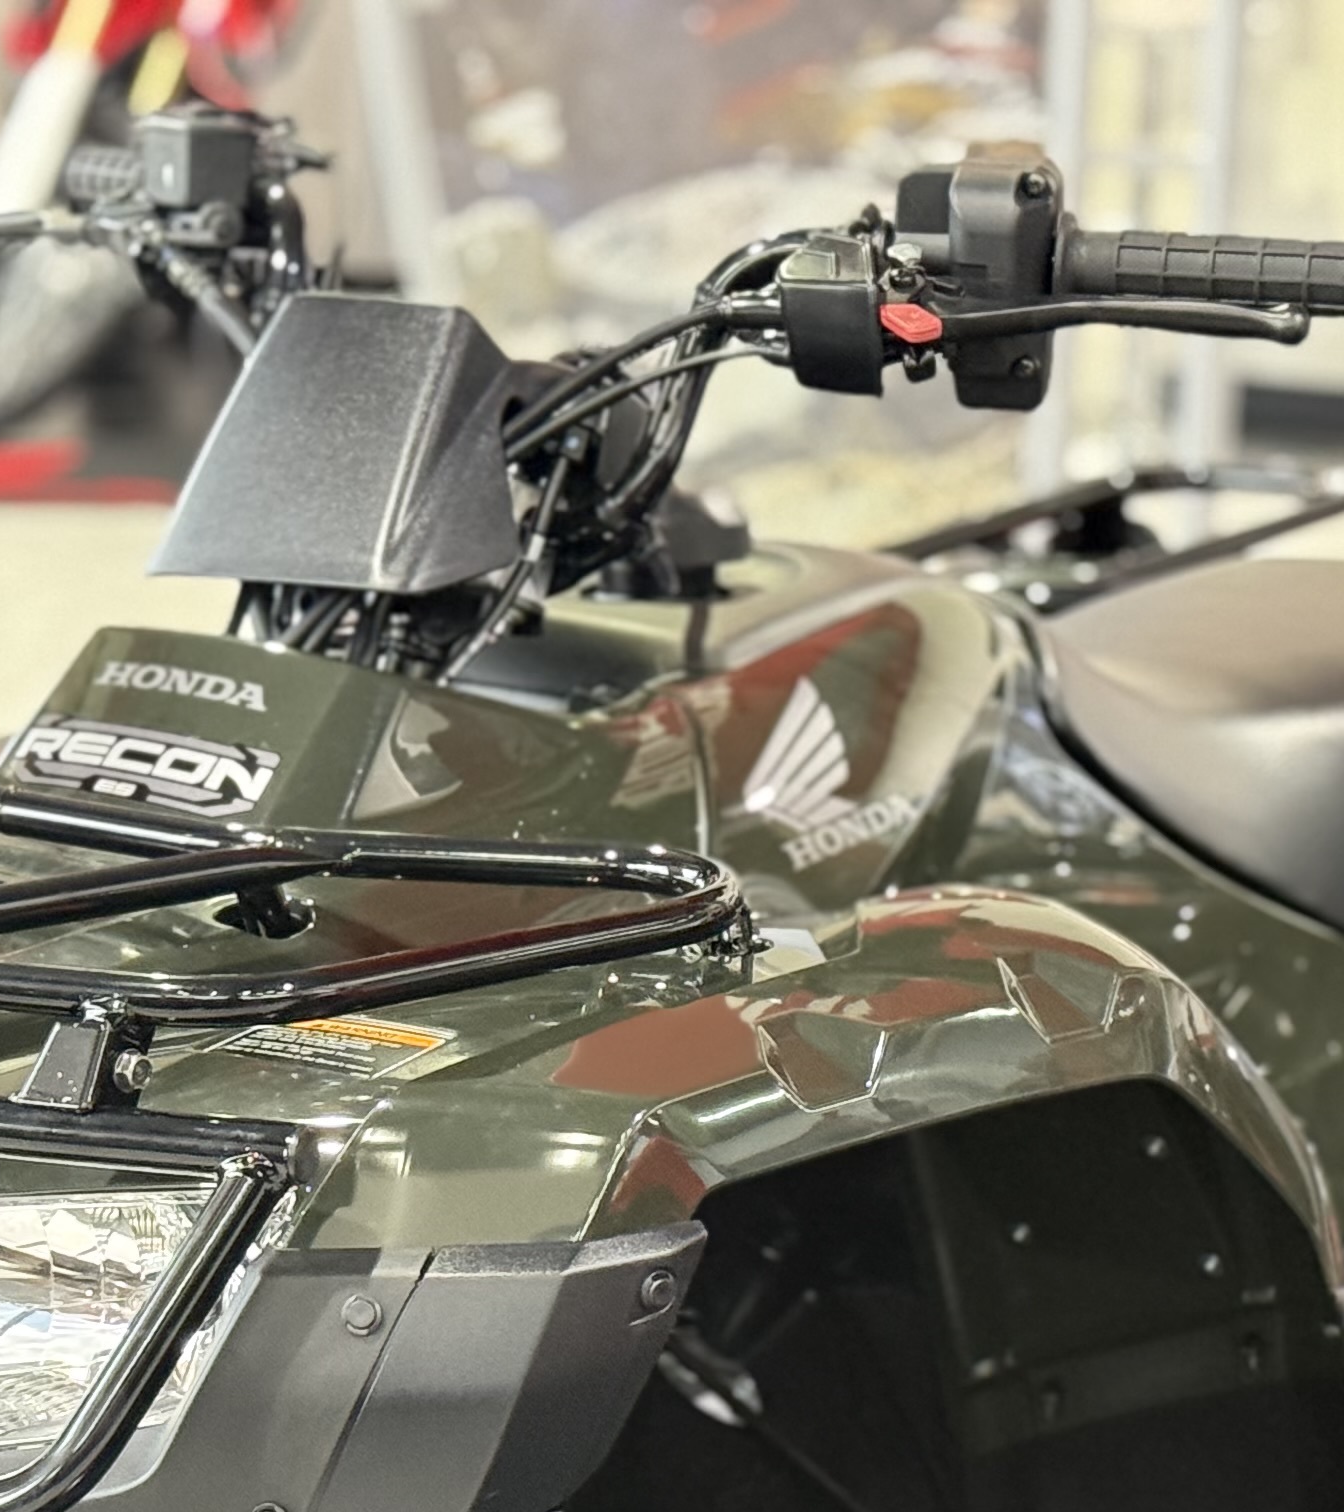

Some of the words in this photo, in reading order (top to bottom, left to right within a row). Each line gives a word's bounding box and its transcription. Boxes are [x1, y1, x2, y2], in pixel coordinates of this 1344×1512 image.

[94, 661, 267, 711] HONDA
[14, 727, 274, 802] RECON
[93, 778, 138, 798] ES
[780, 794, 922, 872] HONDA
